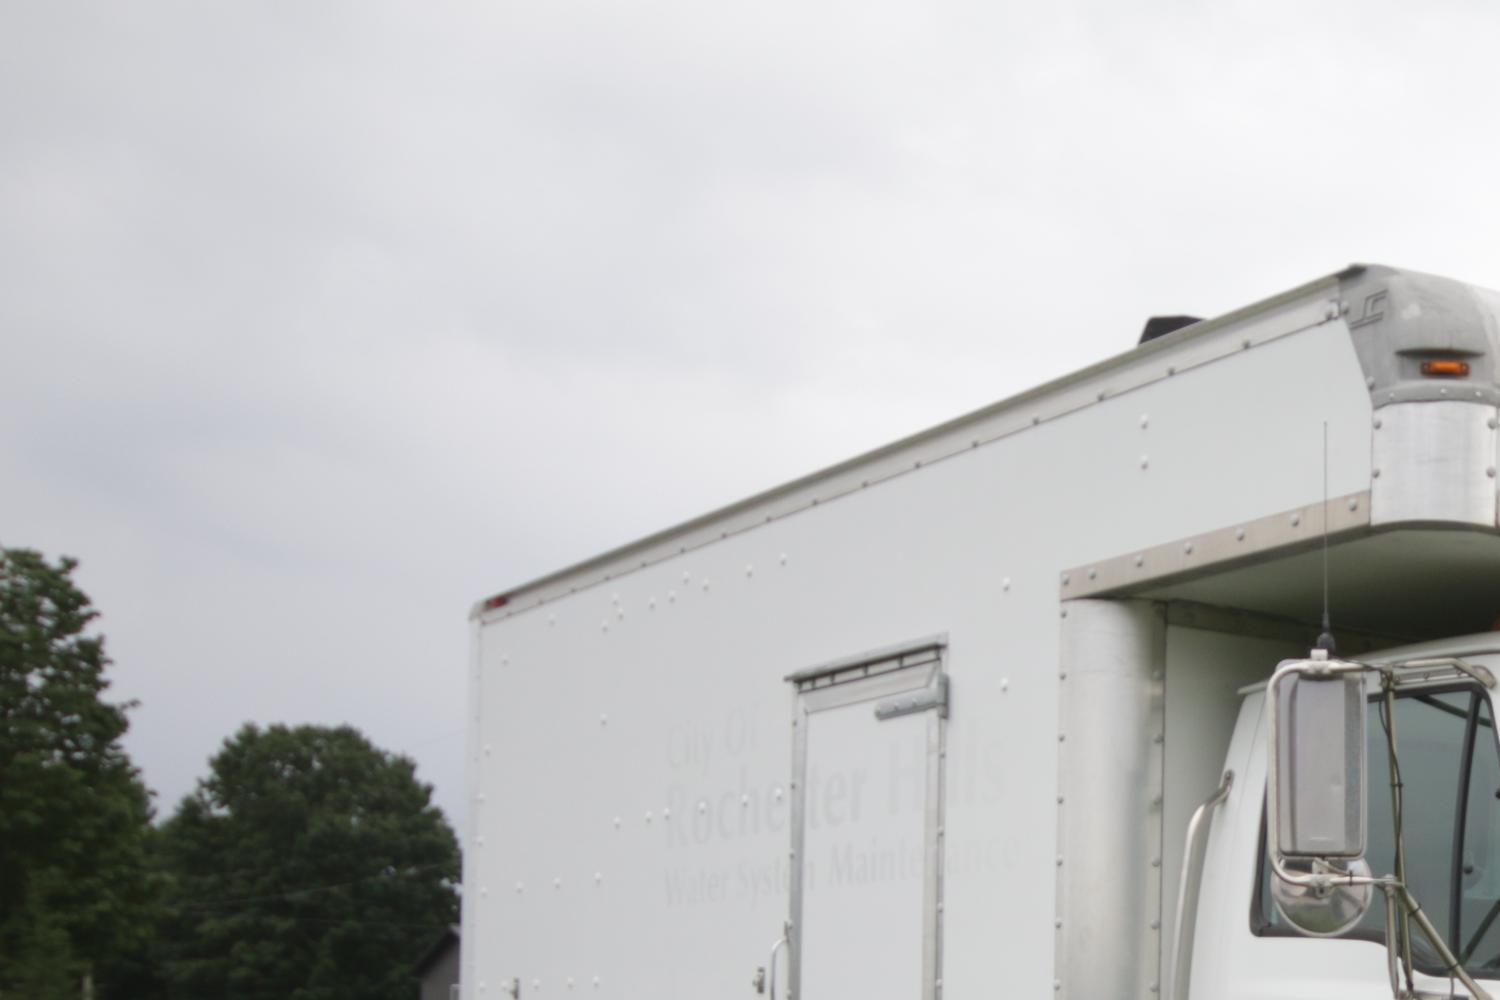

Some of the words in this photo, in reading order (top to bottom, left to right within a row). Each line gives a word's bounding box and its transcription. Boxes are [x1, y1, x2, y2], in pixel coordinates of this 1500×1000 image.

[664, 763, 867, 848] Rocheter
[887, 716, 1008, 816] Hlls
[827, 834, 1020, 888] Mainteance
